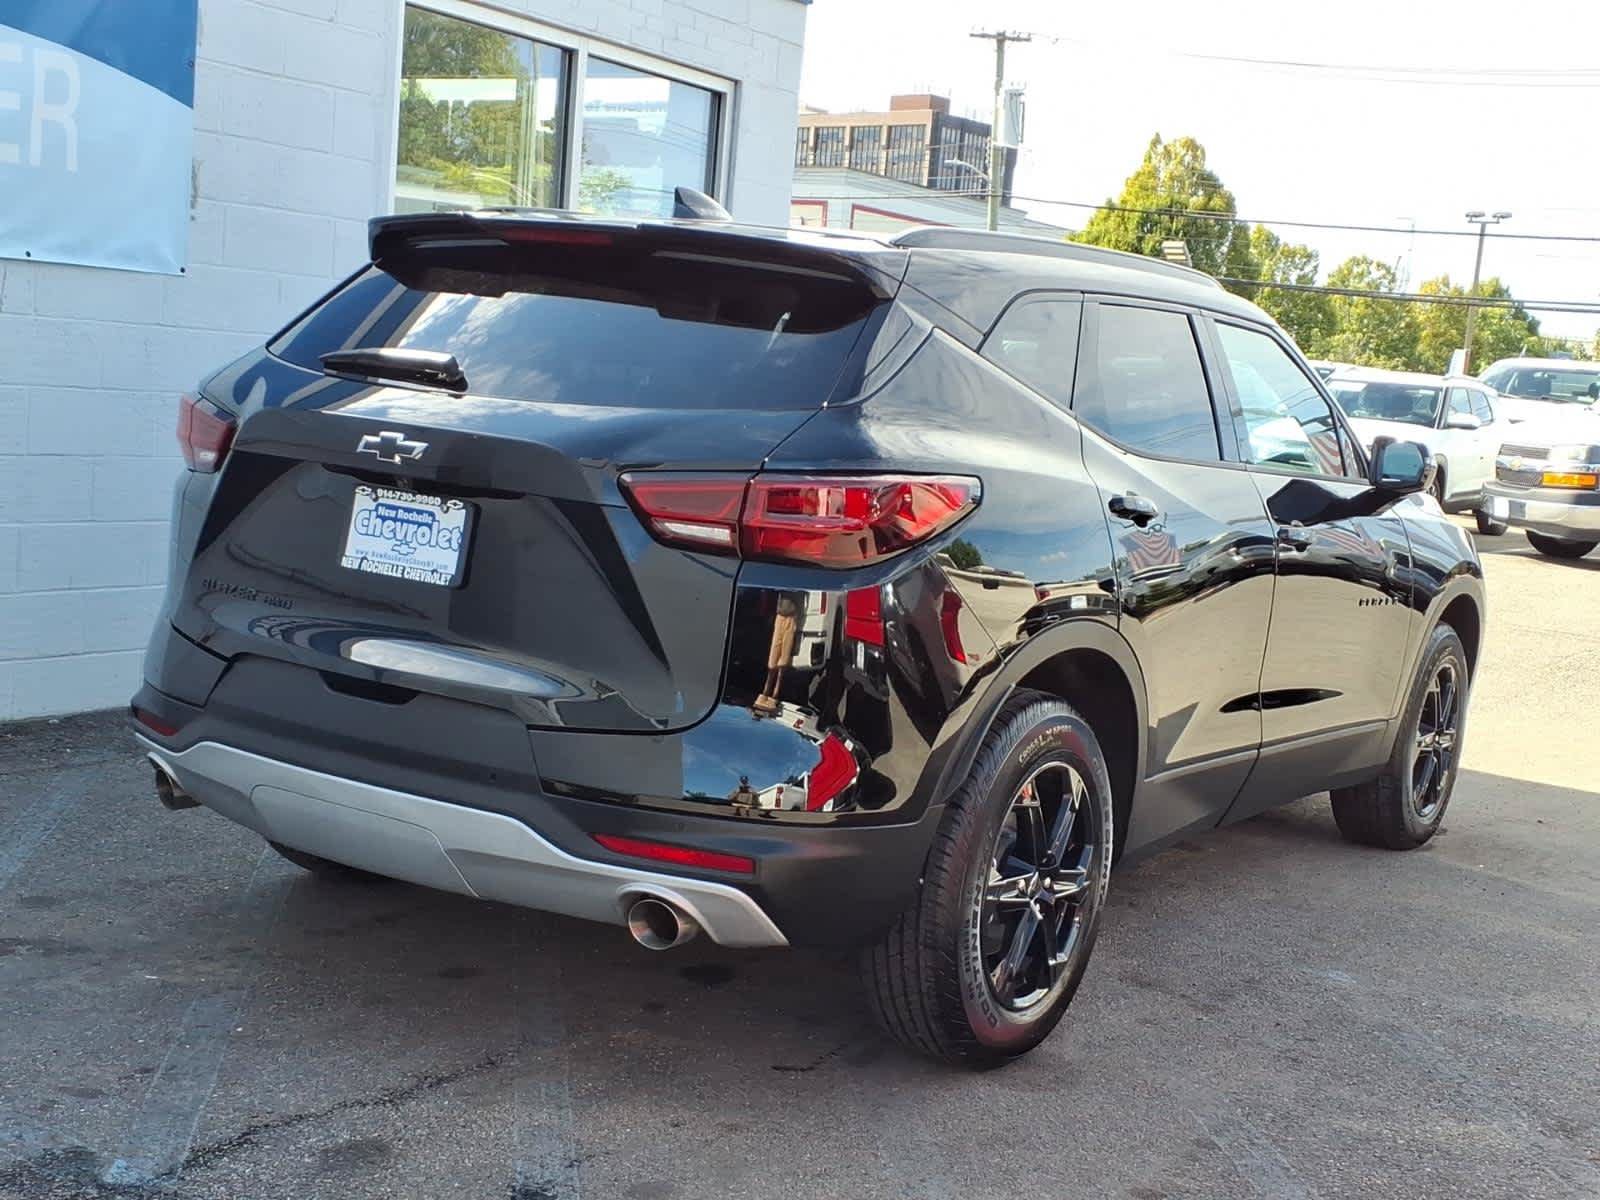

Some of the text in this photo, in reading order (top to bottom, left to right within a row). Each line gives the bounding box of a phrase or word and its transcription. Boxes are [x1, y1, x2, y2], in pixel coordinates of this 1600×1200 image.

[377, 505, 434, 524] New Rochelle
[354, 508, 463, 552] Chevrolet
[340, 556, 452, 586] NEW ROCHELLE CHEVROLET
